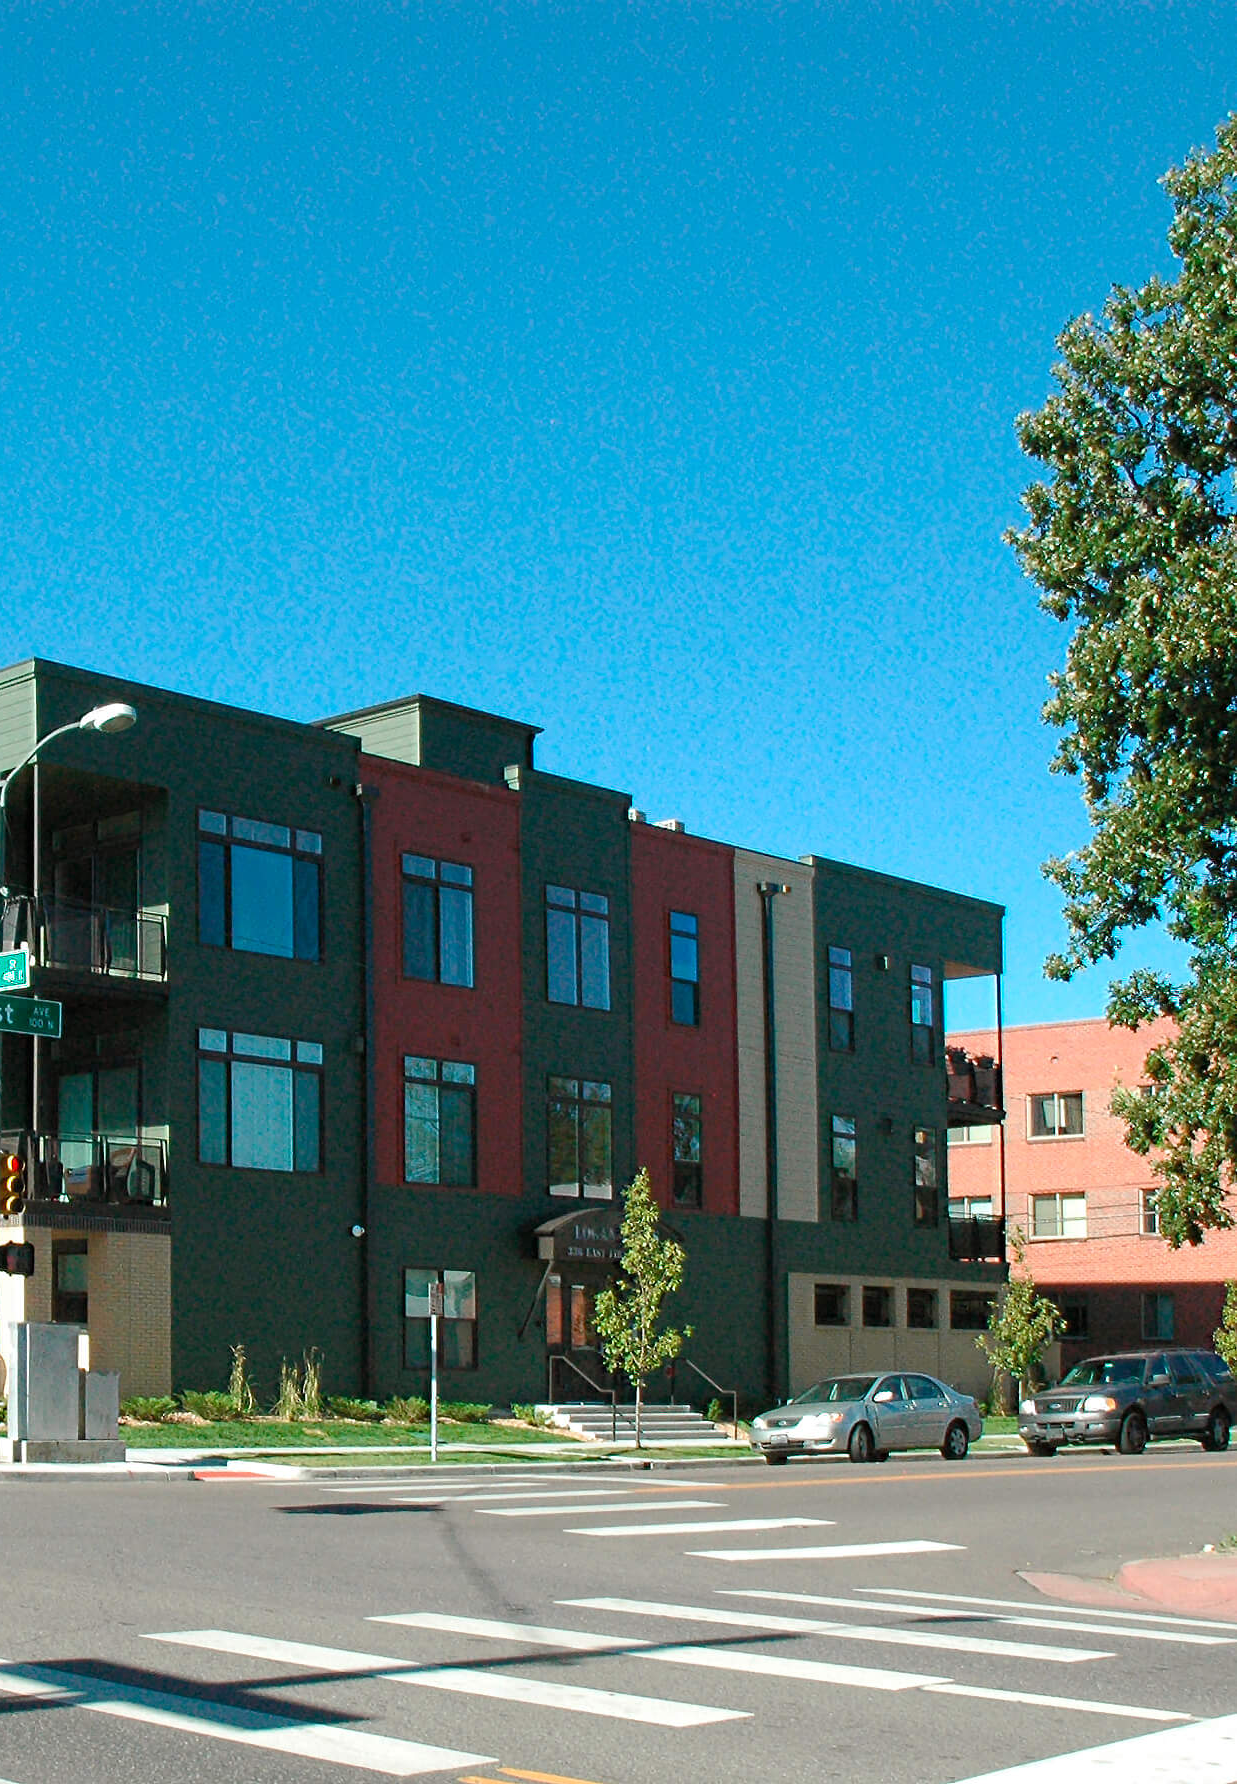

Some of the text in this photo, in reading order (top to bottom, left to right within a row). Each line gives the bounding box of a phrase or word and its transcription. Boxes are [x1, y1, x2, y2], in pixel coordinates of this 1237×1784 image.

[33, 1006, 50, 1017] AVE
[28, 1018, 54, 1030] 100 N
